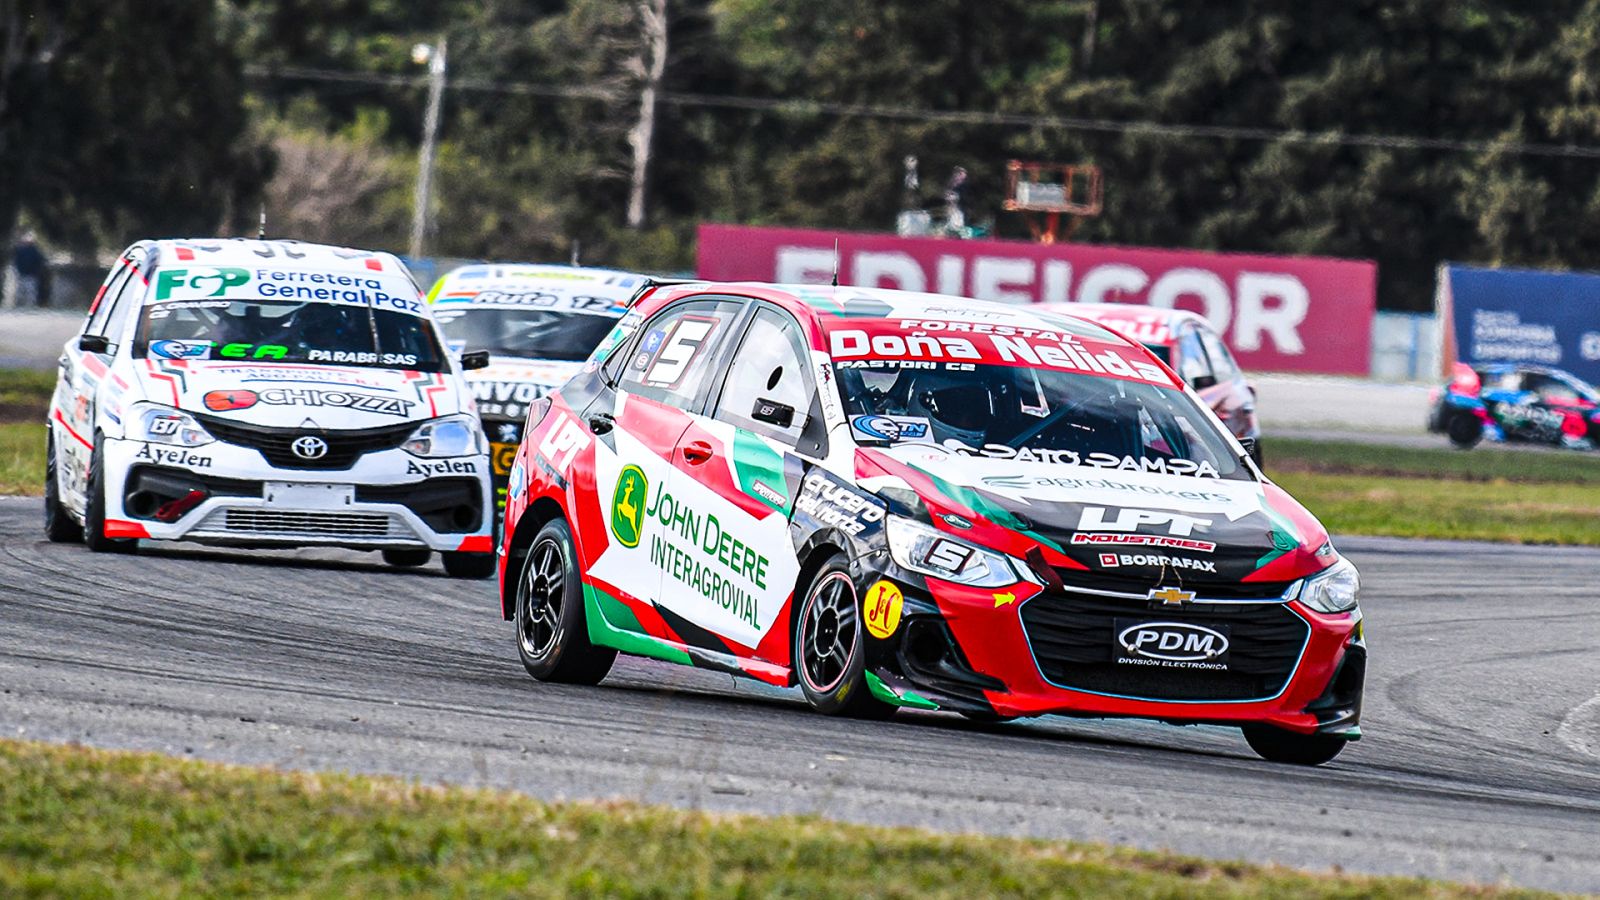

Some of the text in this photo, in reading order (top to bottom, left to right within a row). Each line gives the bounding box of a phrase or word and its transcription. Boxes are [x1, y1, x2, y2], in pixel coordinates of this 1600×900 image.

[257, 269, 382, 290] Ferretera
[258, 283, 421, 314] General Paz
[900, 319, 1082, 345] FORESTAL
[308, 350, 418, 366] PARABRSAS
[647, 318, 714, 384] 5
[829, 329, 1177, 387] Doña Nelida
[836, 360, 937, 370] PASTORI
[136, 443, 212, 467] Ayelen
[407, 460, 477, 477] Ayelen
[804, 474, 886, 522] crucero
[1036, 476, 1233, 502] agrobrokers
[1077, 507, 1213, 537] LPT
[647, 481, 769, 591] JOHN DEERE
[1073, 534, 1215, 551] INDUSTRIES
[1119, 554, 1217, 573] BORDAFAX
[650, 533, 761, 631] INTERAGROVIAL
[1135, 630, 1215, 652] PDM
[1118, 657, 1228, 670] DIVISIÓN ELECTRÓNICA
